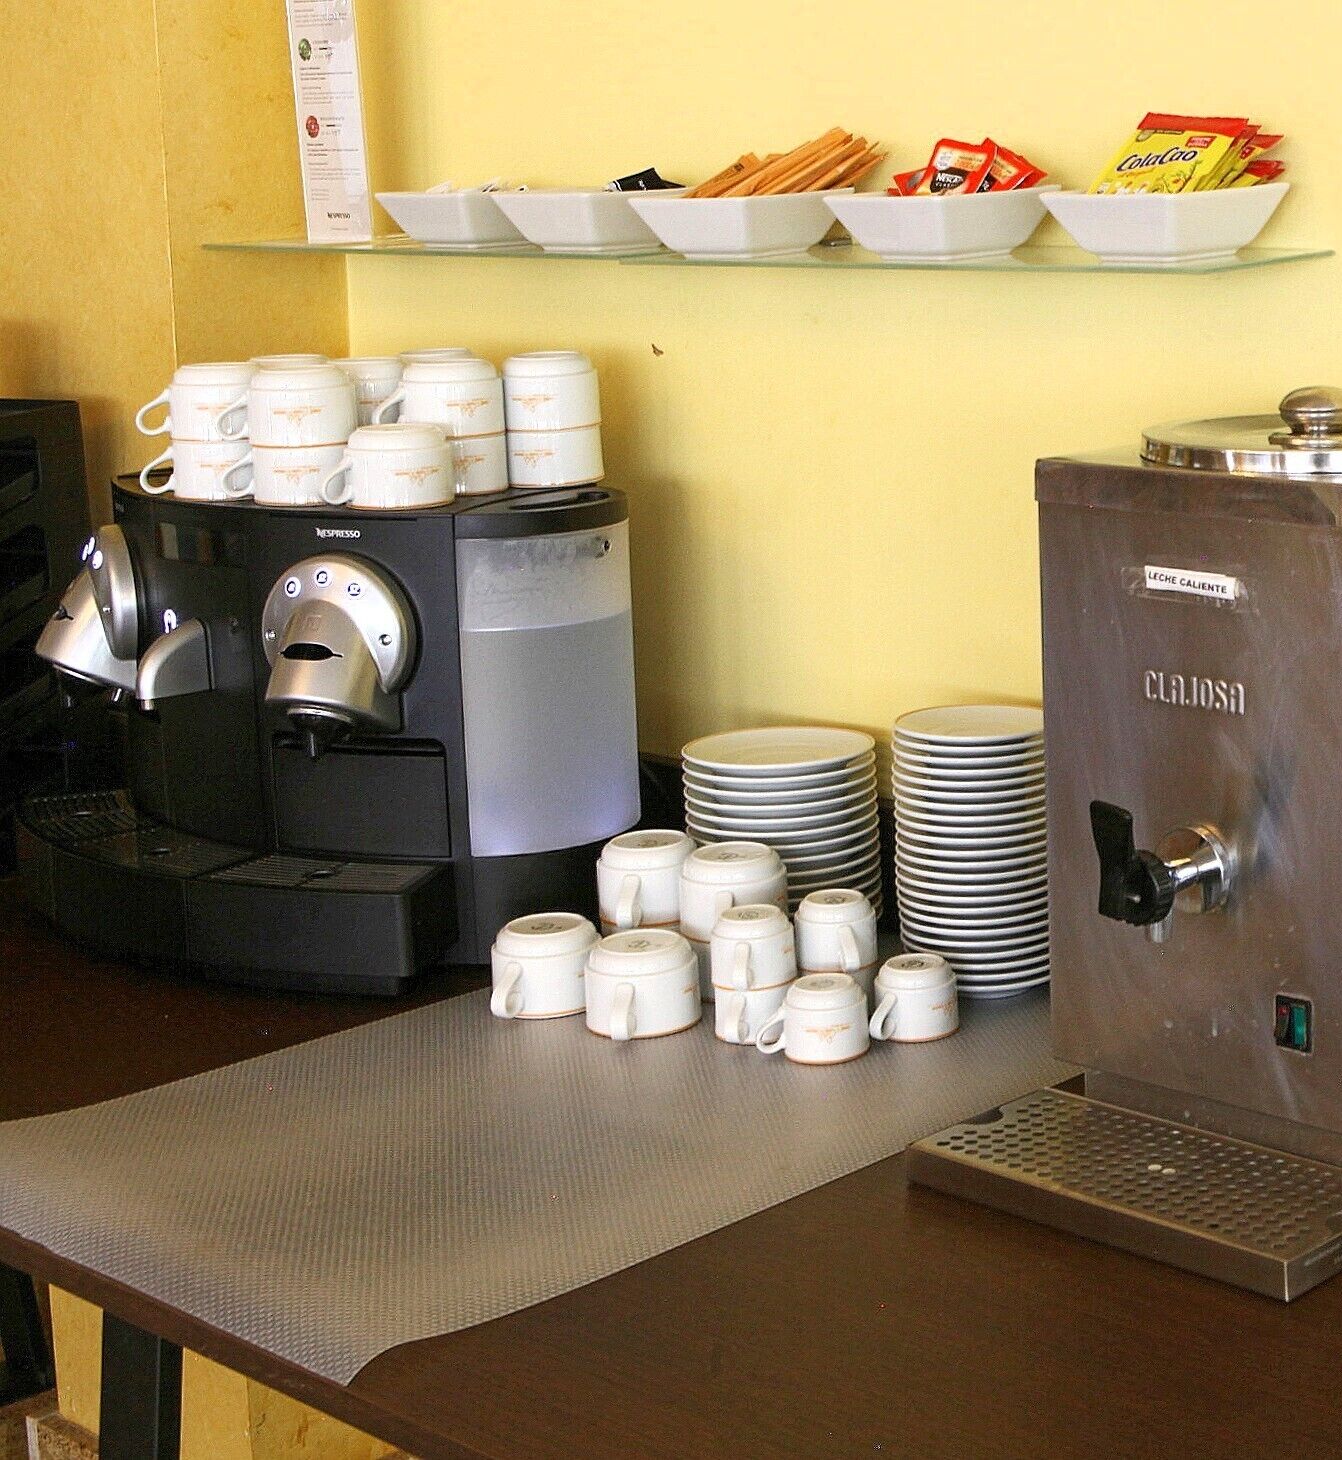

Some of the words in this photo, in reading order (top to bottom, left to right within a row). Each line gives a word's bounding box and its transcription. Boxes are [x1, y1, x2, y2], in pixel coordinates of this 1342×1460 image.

[1116, 147, 1198, 172] ColaCao
[315, 527, 361, 539] NESPRESSO
[1149, 571, 1177, 585] LECHE
[1180, 577, 1227, 594] CALIENTE
